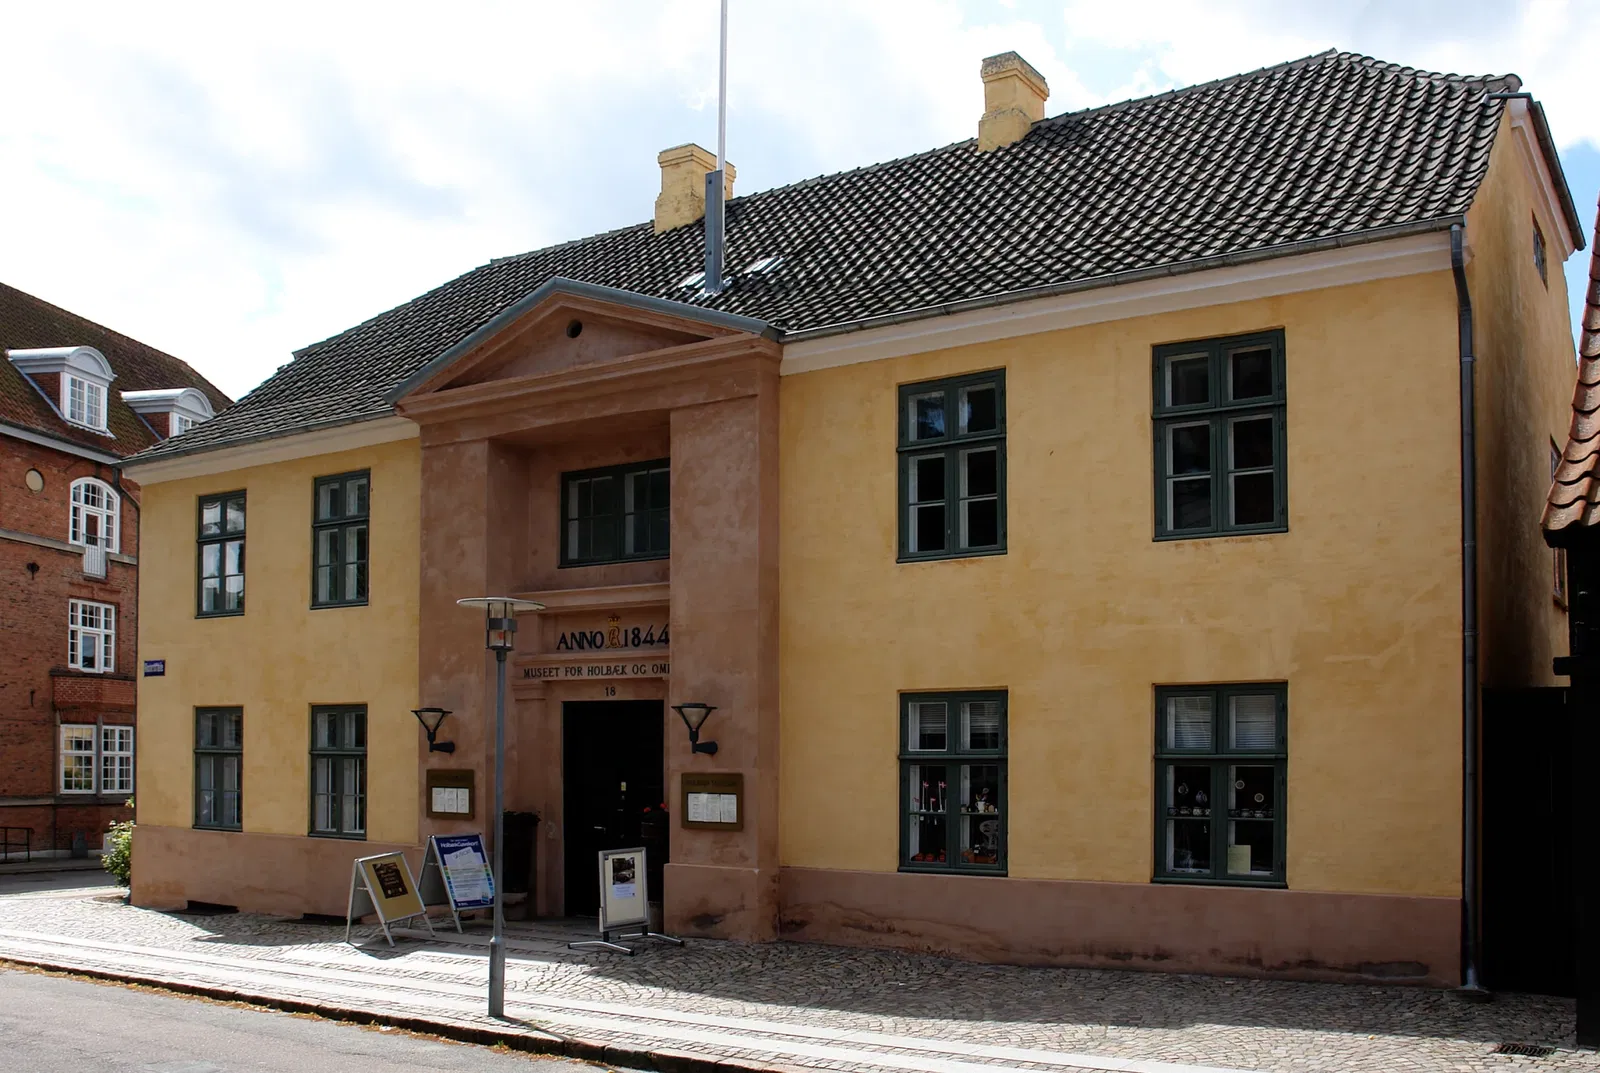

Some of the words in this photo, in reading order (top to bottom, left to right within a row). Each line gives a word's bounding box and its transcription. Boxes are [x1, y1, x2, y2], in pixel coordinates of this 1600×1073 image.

[556, 630, 604, 650] ANNO
[624, 623, 670, 648] 1844
[523, 666, 560, 678] MUSEET
[564, 666, 583, 677] FOR
[587, 664, 628, 677] HOLBÆK
[632, 664, 647, 675] OG
[605, 686, 616, 697] 18
